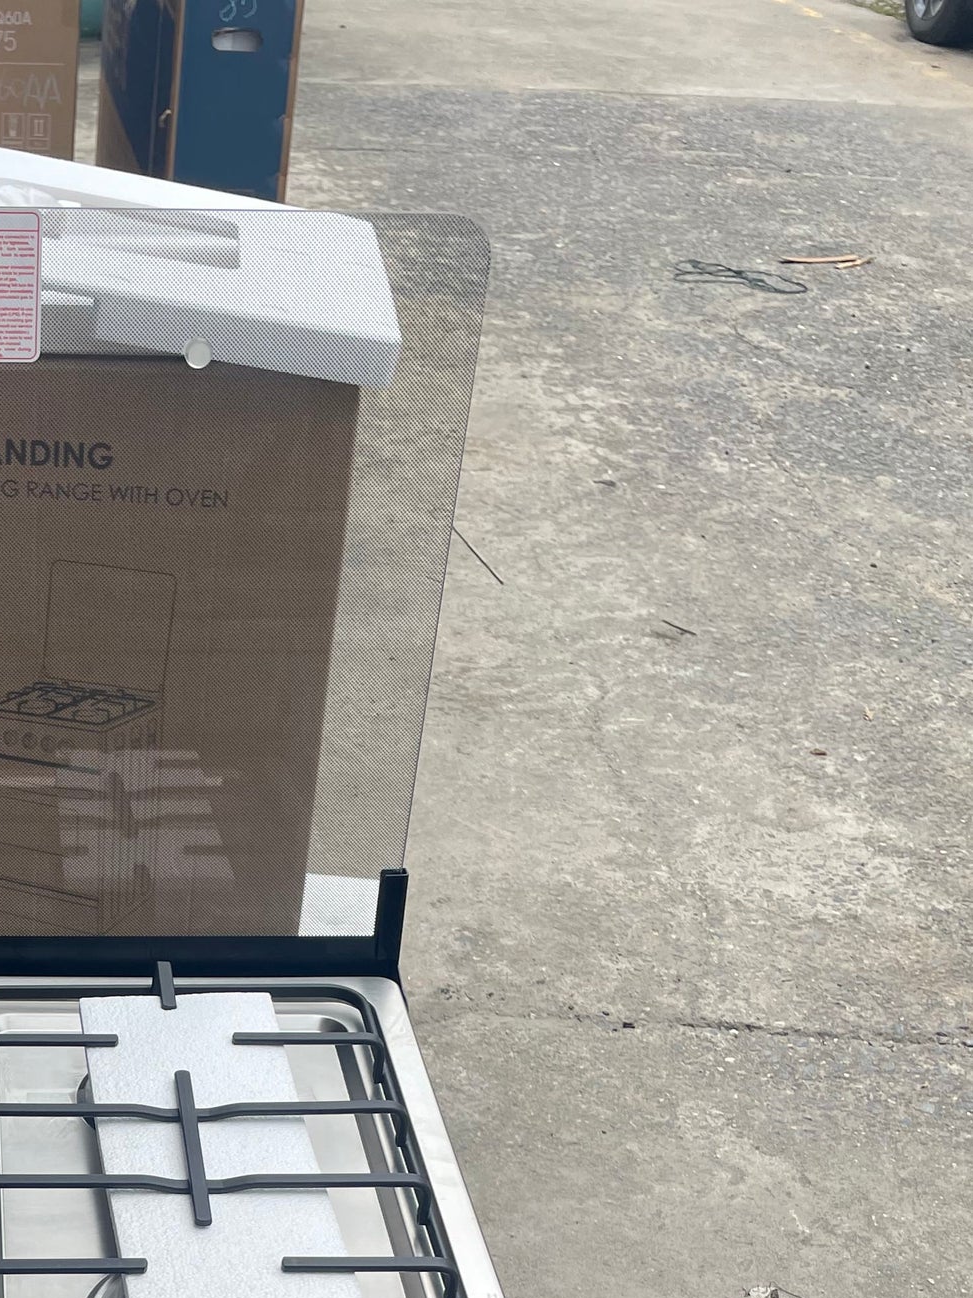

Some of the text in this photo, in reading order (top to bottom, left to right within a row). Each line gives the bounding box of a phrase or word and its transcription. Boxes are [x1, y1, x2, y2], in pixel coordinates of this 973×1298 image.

[27, 481, 103, 502] RANGE
[109, 486, 159, 506] WITH
[165, 488, 229, 509] OVEN
